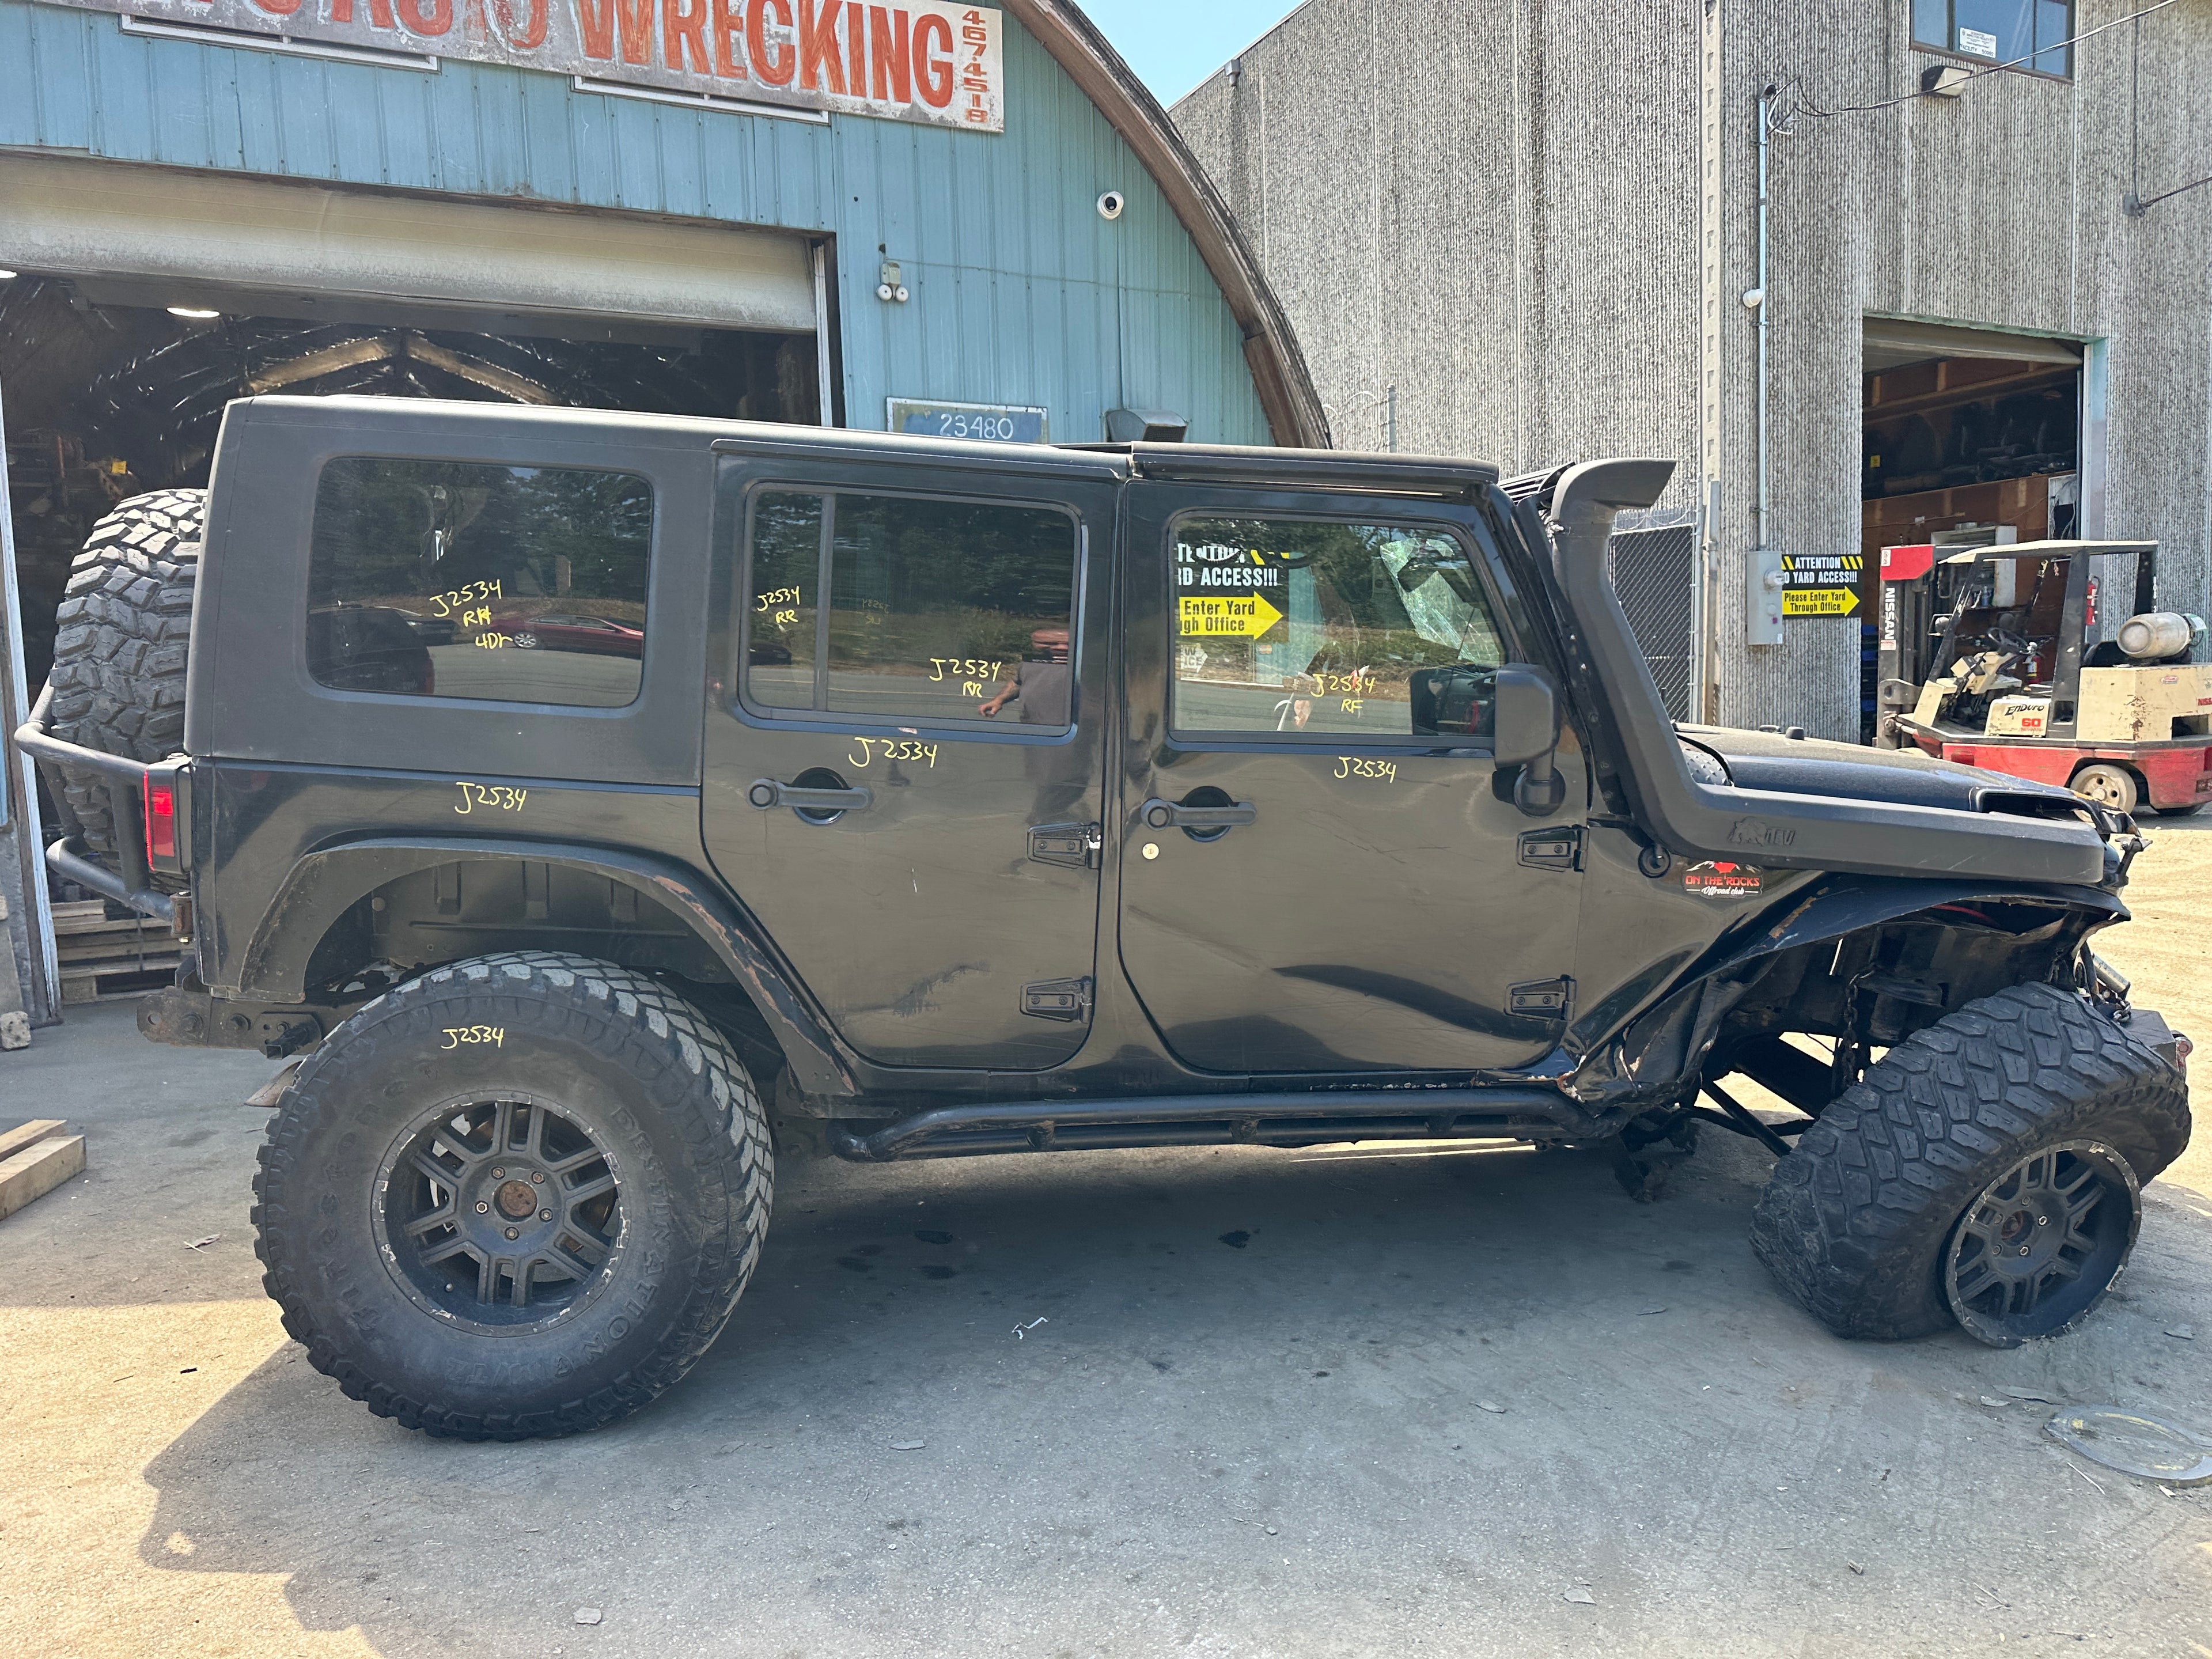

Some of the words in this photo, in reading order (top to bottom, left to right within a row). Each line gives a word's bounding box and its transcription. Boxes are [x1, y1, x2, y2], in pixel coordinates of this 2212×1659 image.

[578, 0, 953, 108] WRECKING
[939, 413, 1014, 440] 23480
[1795, 556, 1841, 569] ATTENTION
[1200, 567, 1278, 586] ACCESS!!!
[1793, 571, 1815, 584] YARD
[1818, 571, 1857, 583] ACCESS!!!
[429, 579, 501, 617] J2534
[757, 585, 800, 611] J2534
[1784, 592, 1807, 602] Please
[1810, 592, 1828, 601] Enter
[1831, 591, 1846, 601] Yard
[775, 609, 798, 623] RR
[1185, 600, 1220, 615] Enter
[1226, 600, 1255, 615] Yard
[1790, 603, 1817, 613] Through
[1820, 602, 1840, 612] Office
[1885, 588, 1895, 639] NISSAN
[1205, 616, 1245, 632] Office
[929, 658, 1002, 682] J2534
[963, 681, 983, 698] RR
[1310, 673, 1376, 698] J2534
[1340, 699, 1364, 714] RF
[2022, 718, 2041, 727] 60
[848, 737, 937, 768] J2534
[1334, 756, 1396, 783] J2534
[454, 782, 527, 814] J2534
[1685, 876, 1700, 885] ON
[1704, 876, 1723, 885] THE
[1725, 877, 1760, 887] ROCKS
[441, 1025, 504, 1048] J2534
